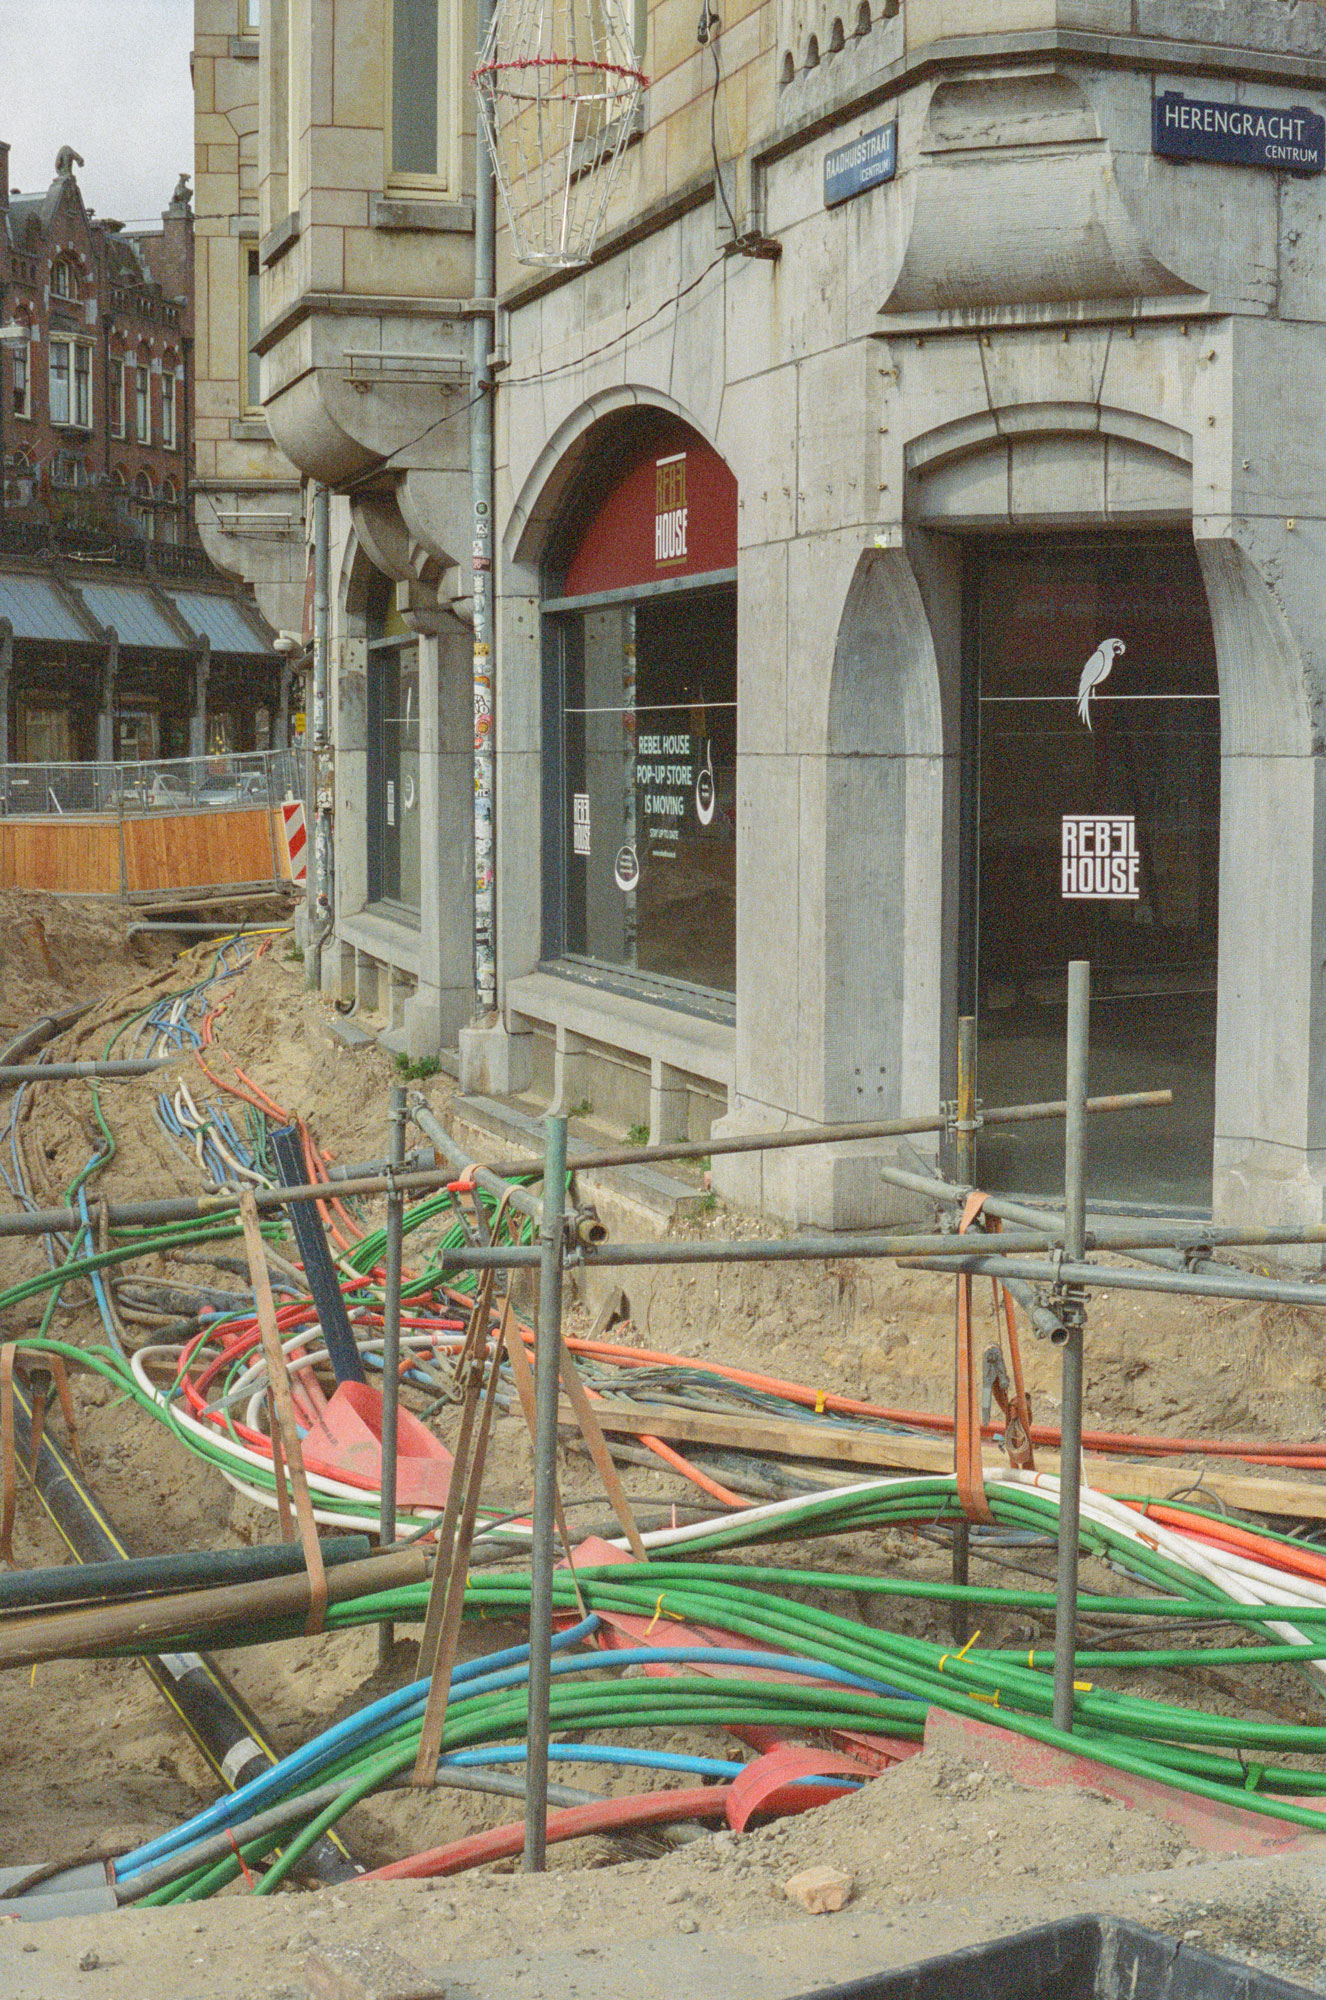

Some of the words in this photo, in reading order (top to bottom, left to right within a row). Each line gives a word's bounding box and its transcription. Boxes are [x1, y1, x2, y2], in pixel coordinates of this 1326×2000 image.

[1165, 104, 1305, 141] HERENGRACHT
[826, 129, 891, 180] RAADHUISSTRAAT
[1265, 145, 1318, 163] CENTRUM
[861, 157, 891, 182] CENTRUM
[655, 508, 688, 560] HOUSE
[638, 735, 662, 755] REBEL
[663, 735, 690, 755] HOUSE
[636, 765, 665, 784] POP-UP
[666, 765, 692, 786] STORE
[644, 794, 651, 813] IS
[652, 796, 684, 816] MOVING
[1062, 822, 1140, 857] REBEL
[1062, 857, 1140, 893] HOUSE
